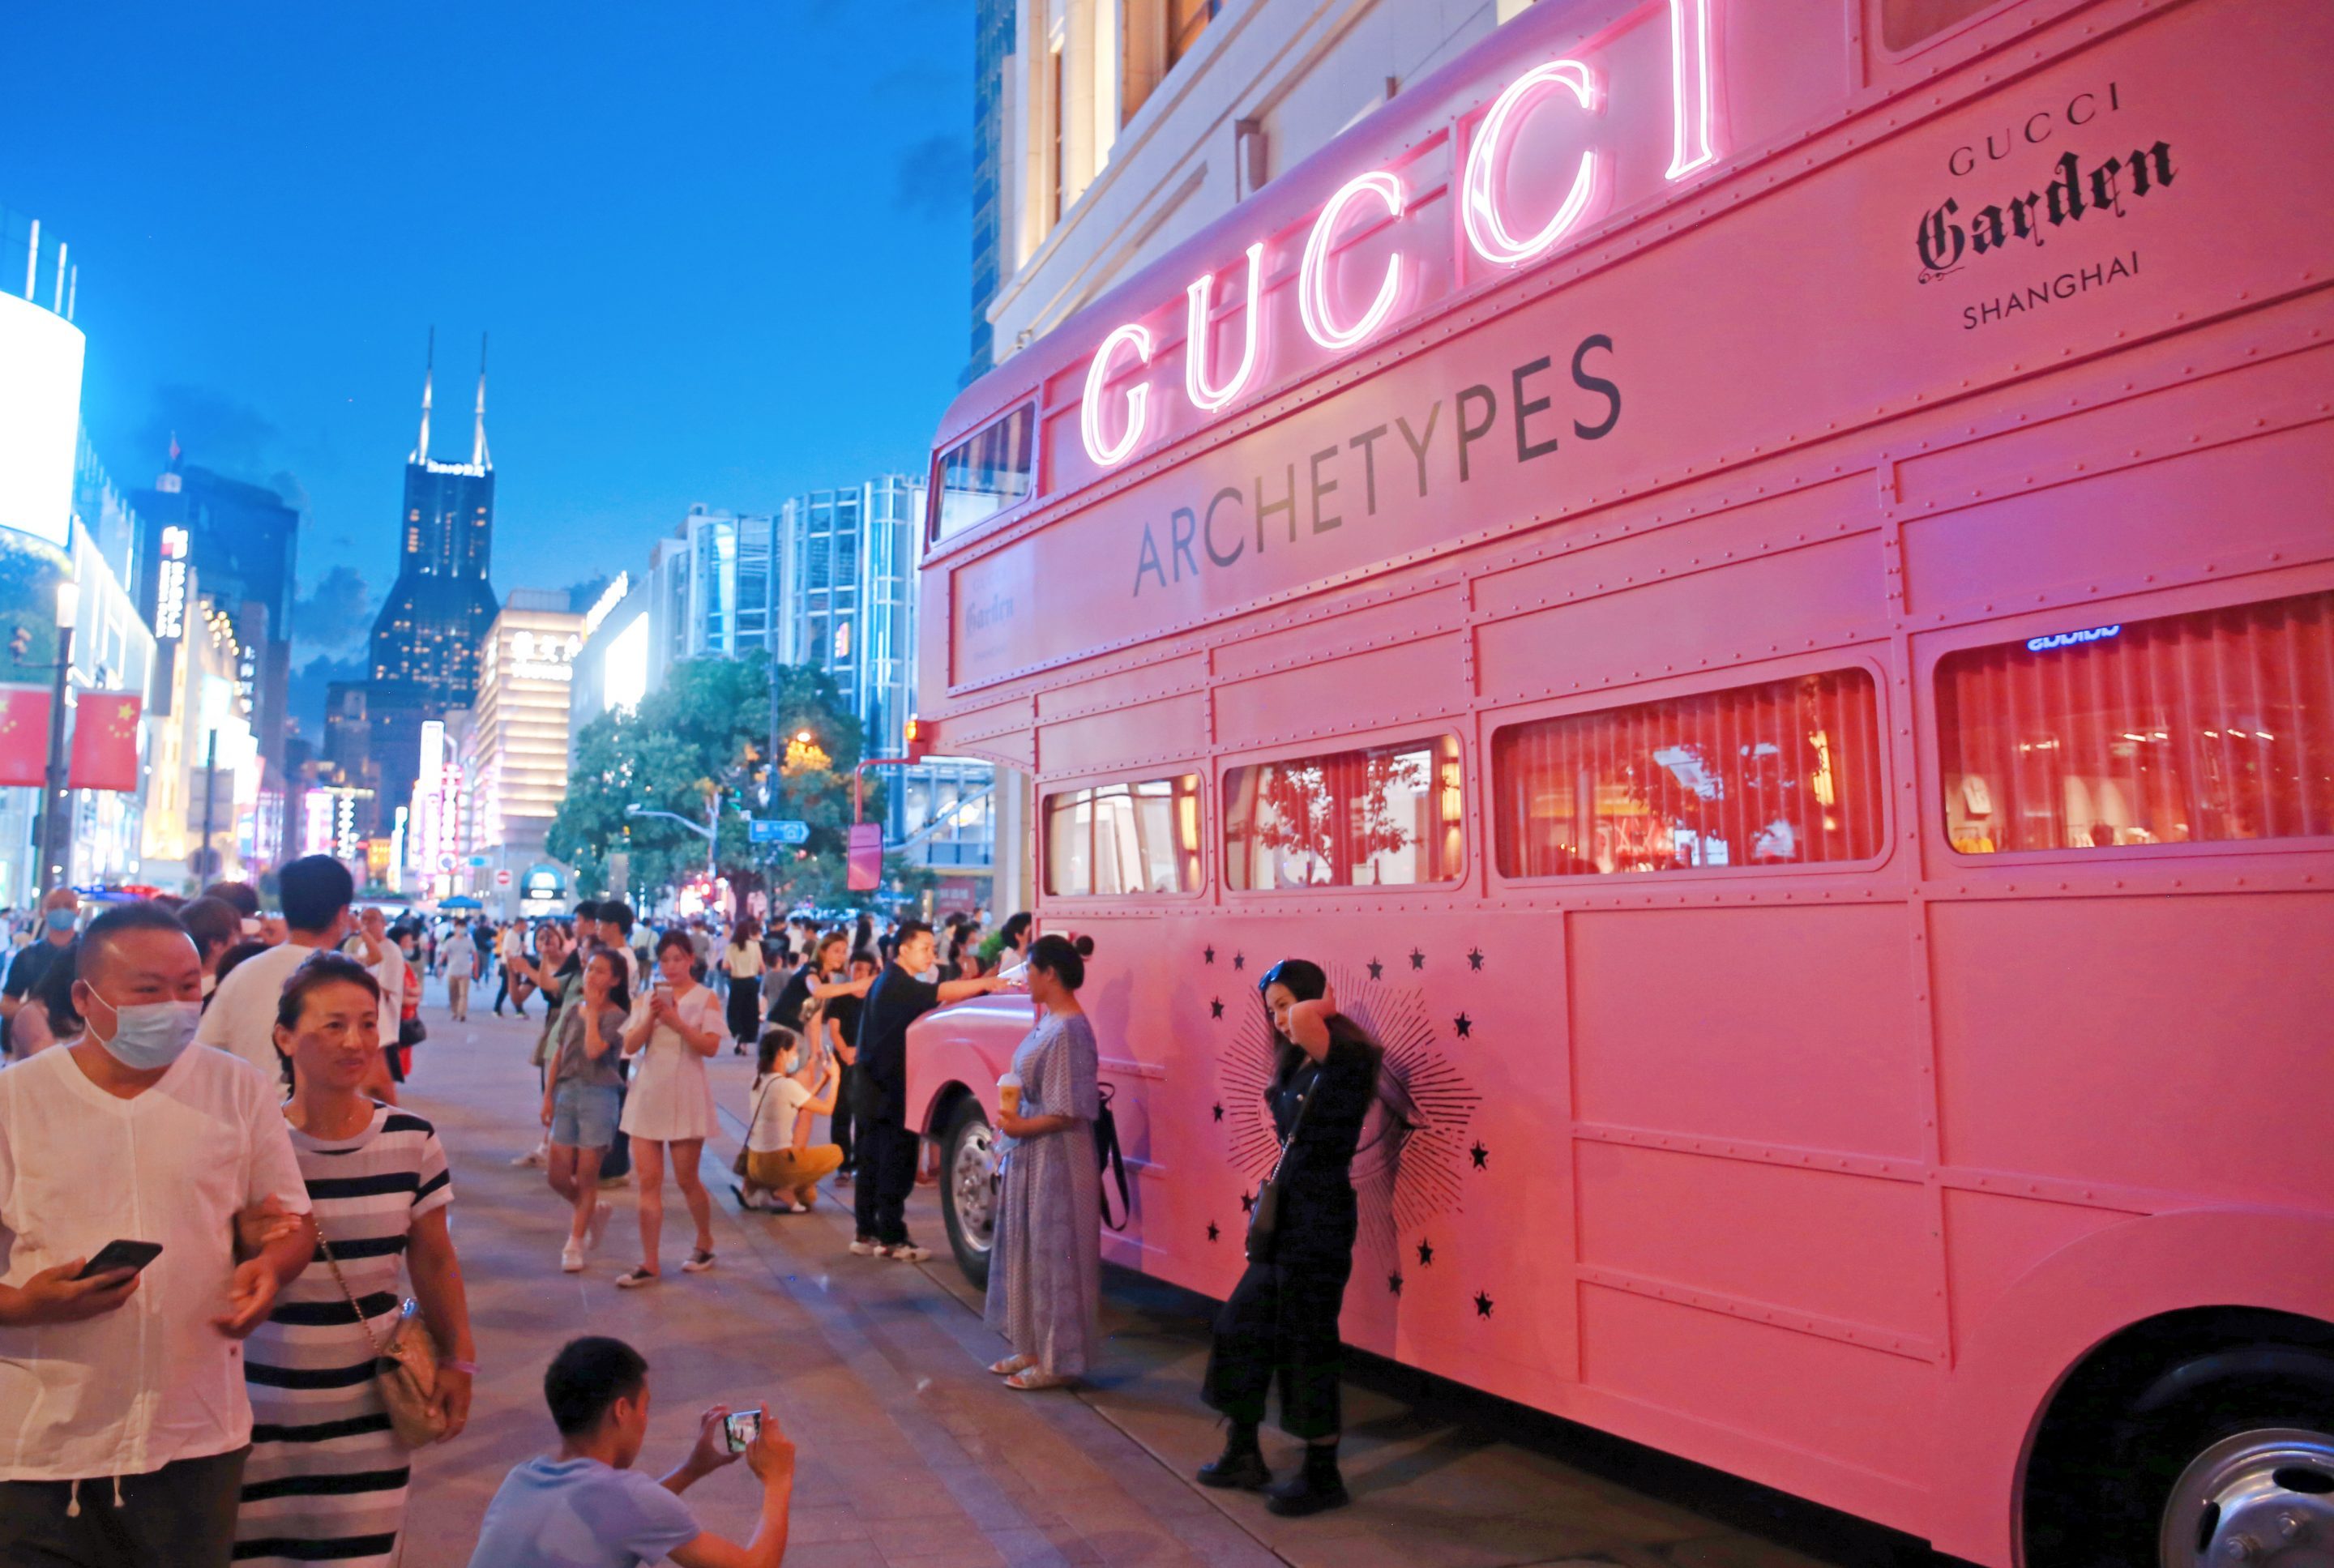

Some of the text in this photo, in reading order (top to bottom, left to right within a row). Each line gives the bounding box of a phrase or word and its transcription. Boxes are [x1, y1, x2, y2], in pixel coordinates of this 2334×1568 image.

[1948, 82, 2121, 176] GUCCI
[1081, 0, 1715, 468] GUCCI
[1916, 140, 2178, 284] Garden
[1962, 250, 2140, 329] SHANGHAI
[1133, 333, 1622, 597] ARCHETYPES
